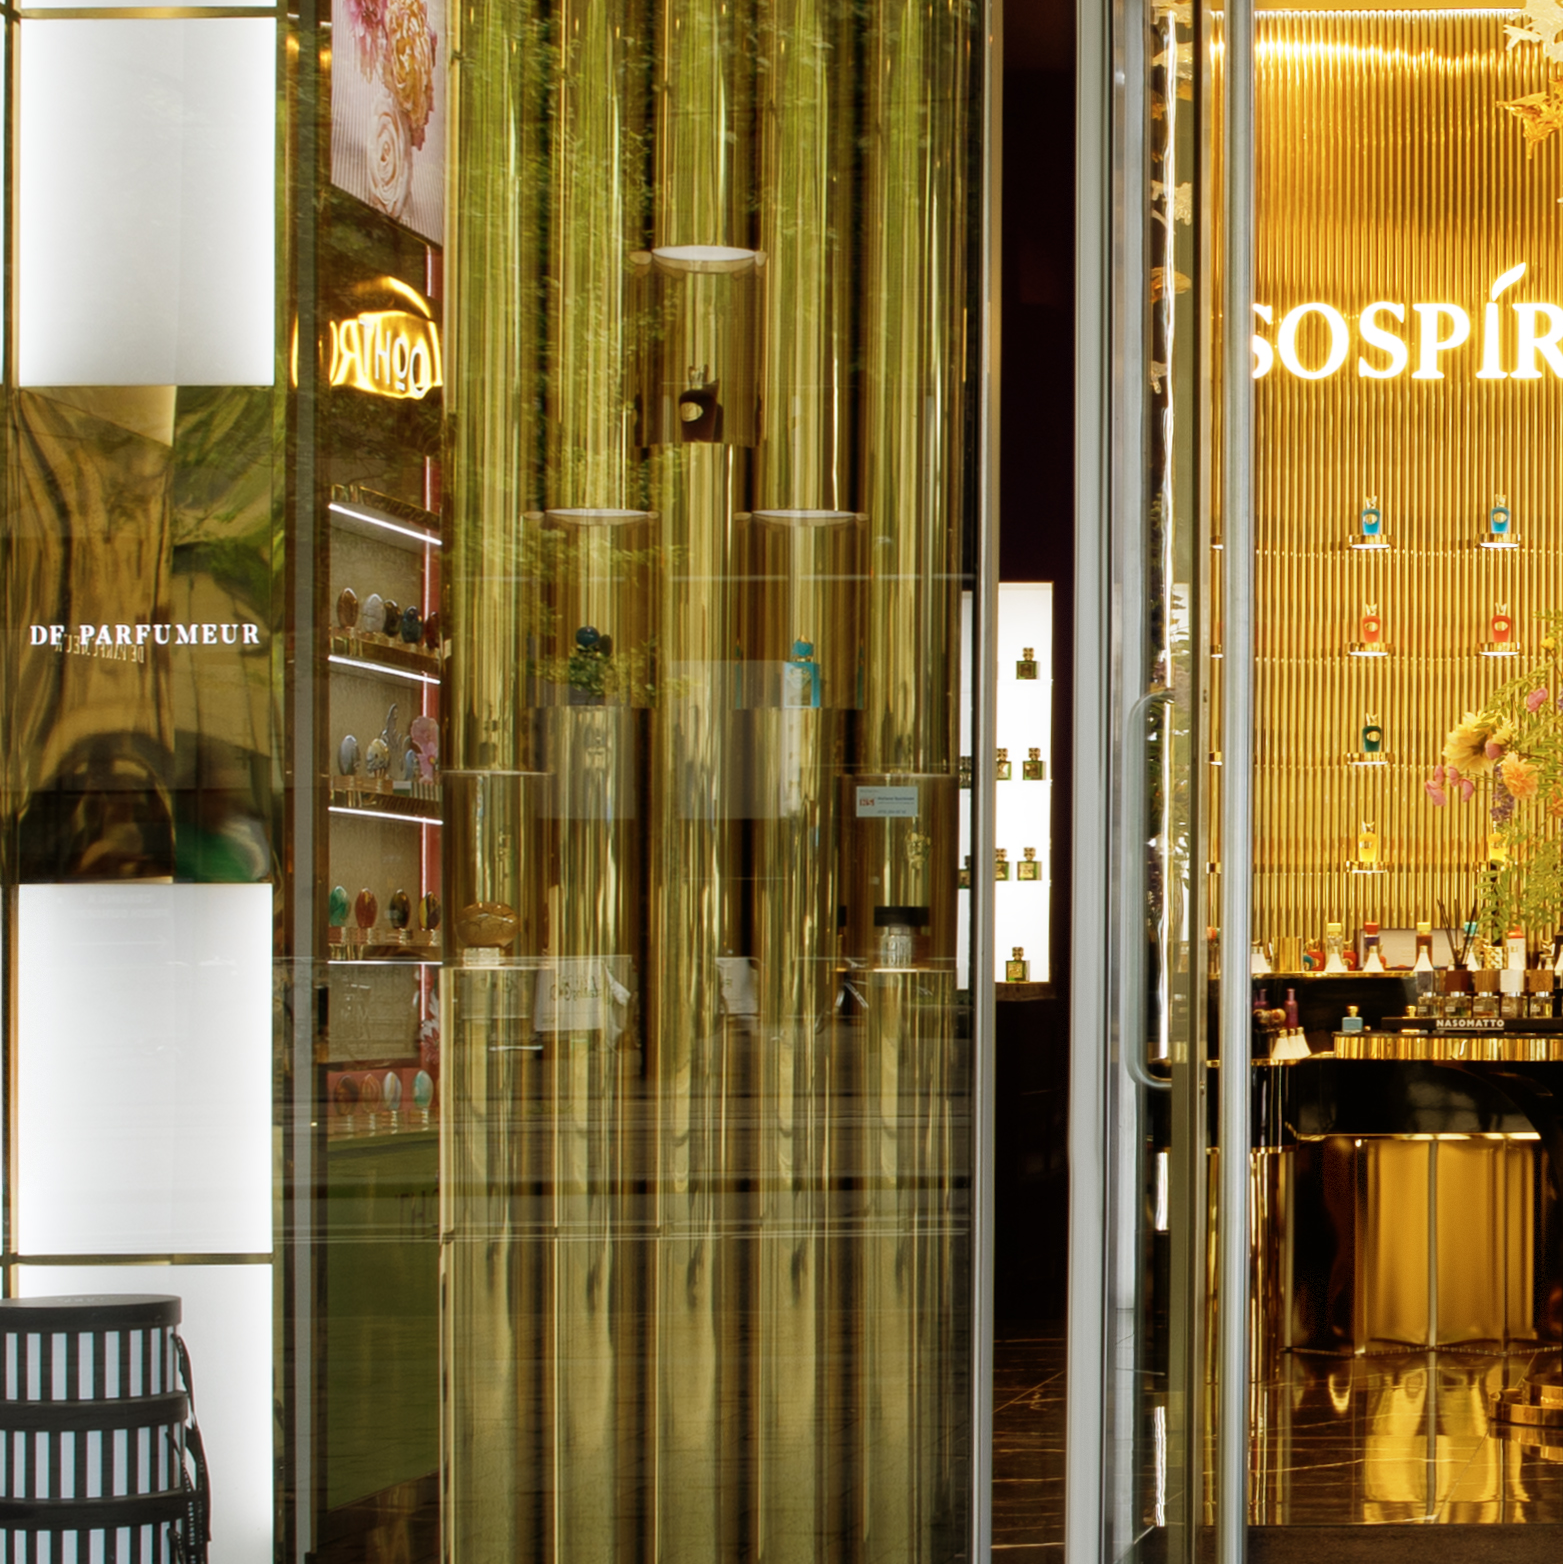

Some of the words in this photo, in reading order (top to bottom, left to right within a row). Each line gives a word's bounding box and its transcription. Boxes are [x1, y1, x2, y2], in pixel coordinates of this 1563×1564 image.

[30, 625, 65, 645] DE
[79, 624, 260, 645] PARFUMEUR
[1436, 1019, 1505, 1028] NASOMATTO
